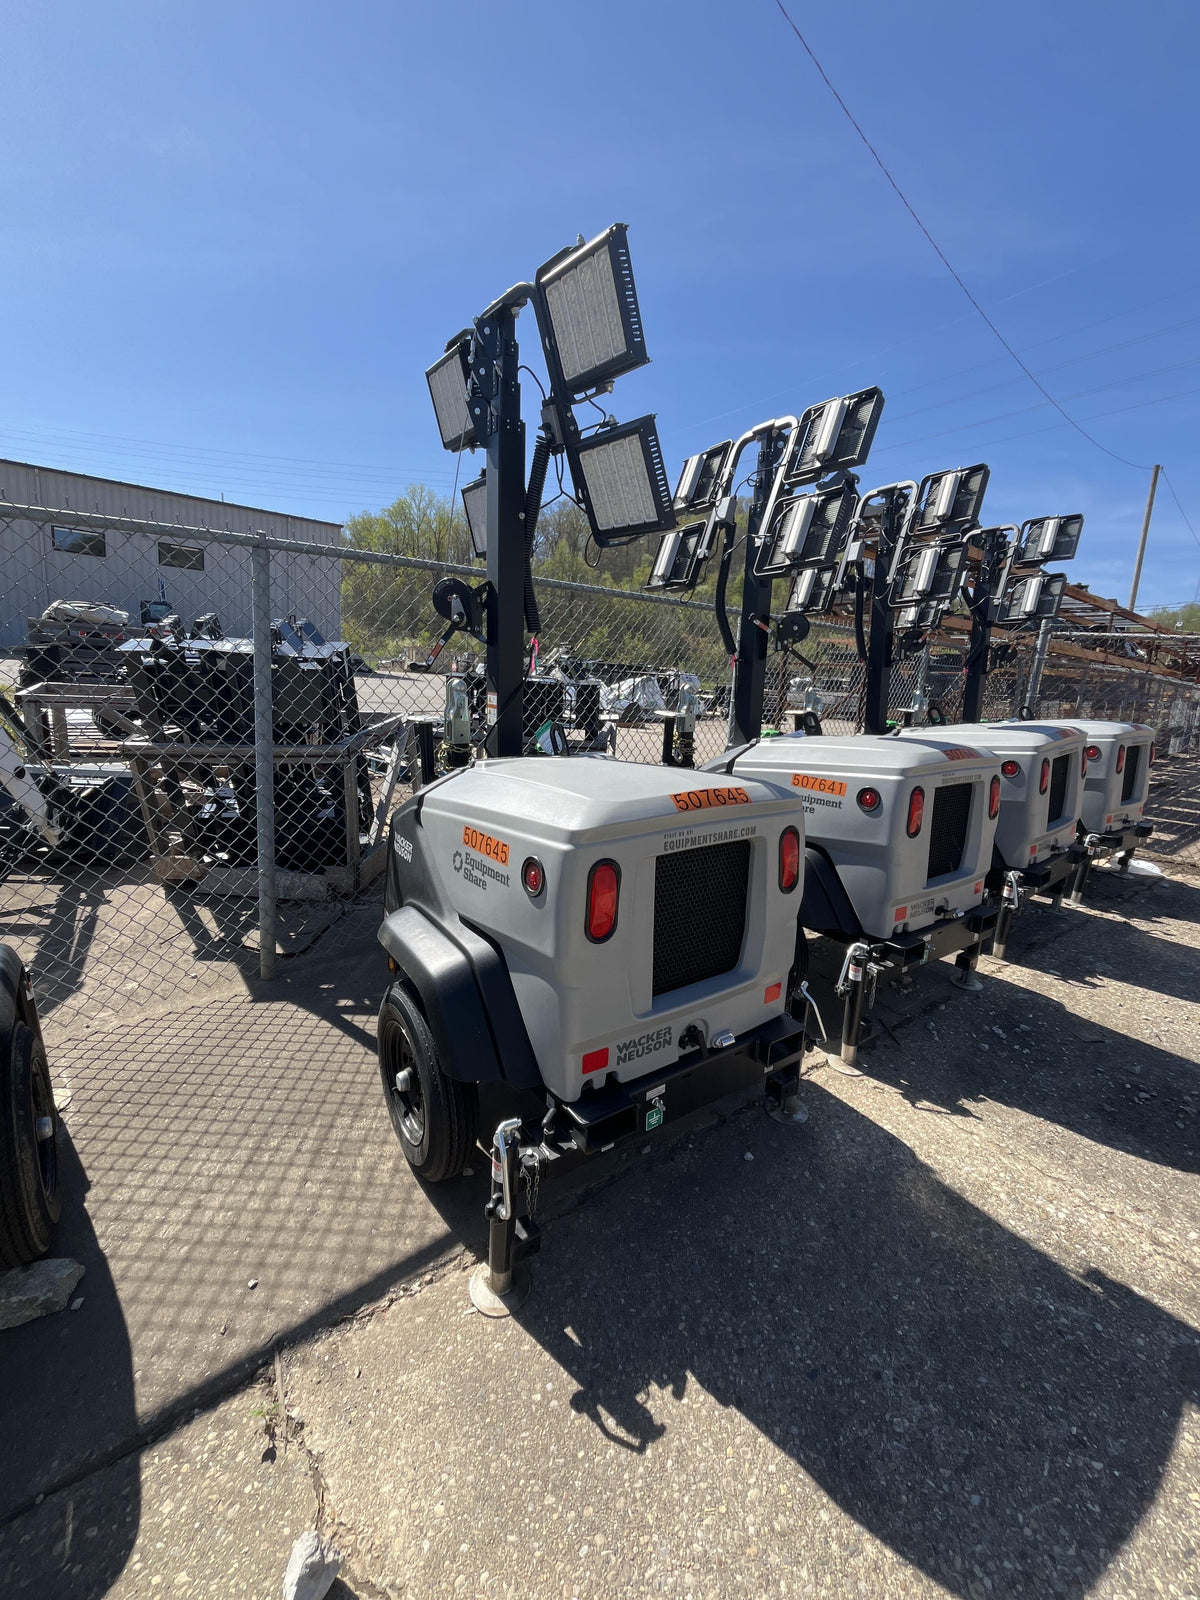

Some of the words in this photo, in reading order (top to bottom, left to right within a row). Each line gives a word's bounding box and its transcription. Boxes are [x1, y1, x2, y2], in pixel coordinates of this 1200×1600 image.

[792, 773, 844, 795] 507641
[673, 787, 749, 811] 507645
[463, 826, 508, 864] 507645
[663, 825, 757, 851] EQUIPMENTSHARE.COM
[463, 867, 487, 890] Share
[464, 852, 511, 887] Equipment
[616, 1026, 672, 1054] WACKER
[616, 1036, 673, 1066] NEUSON
